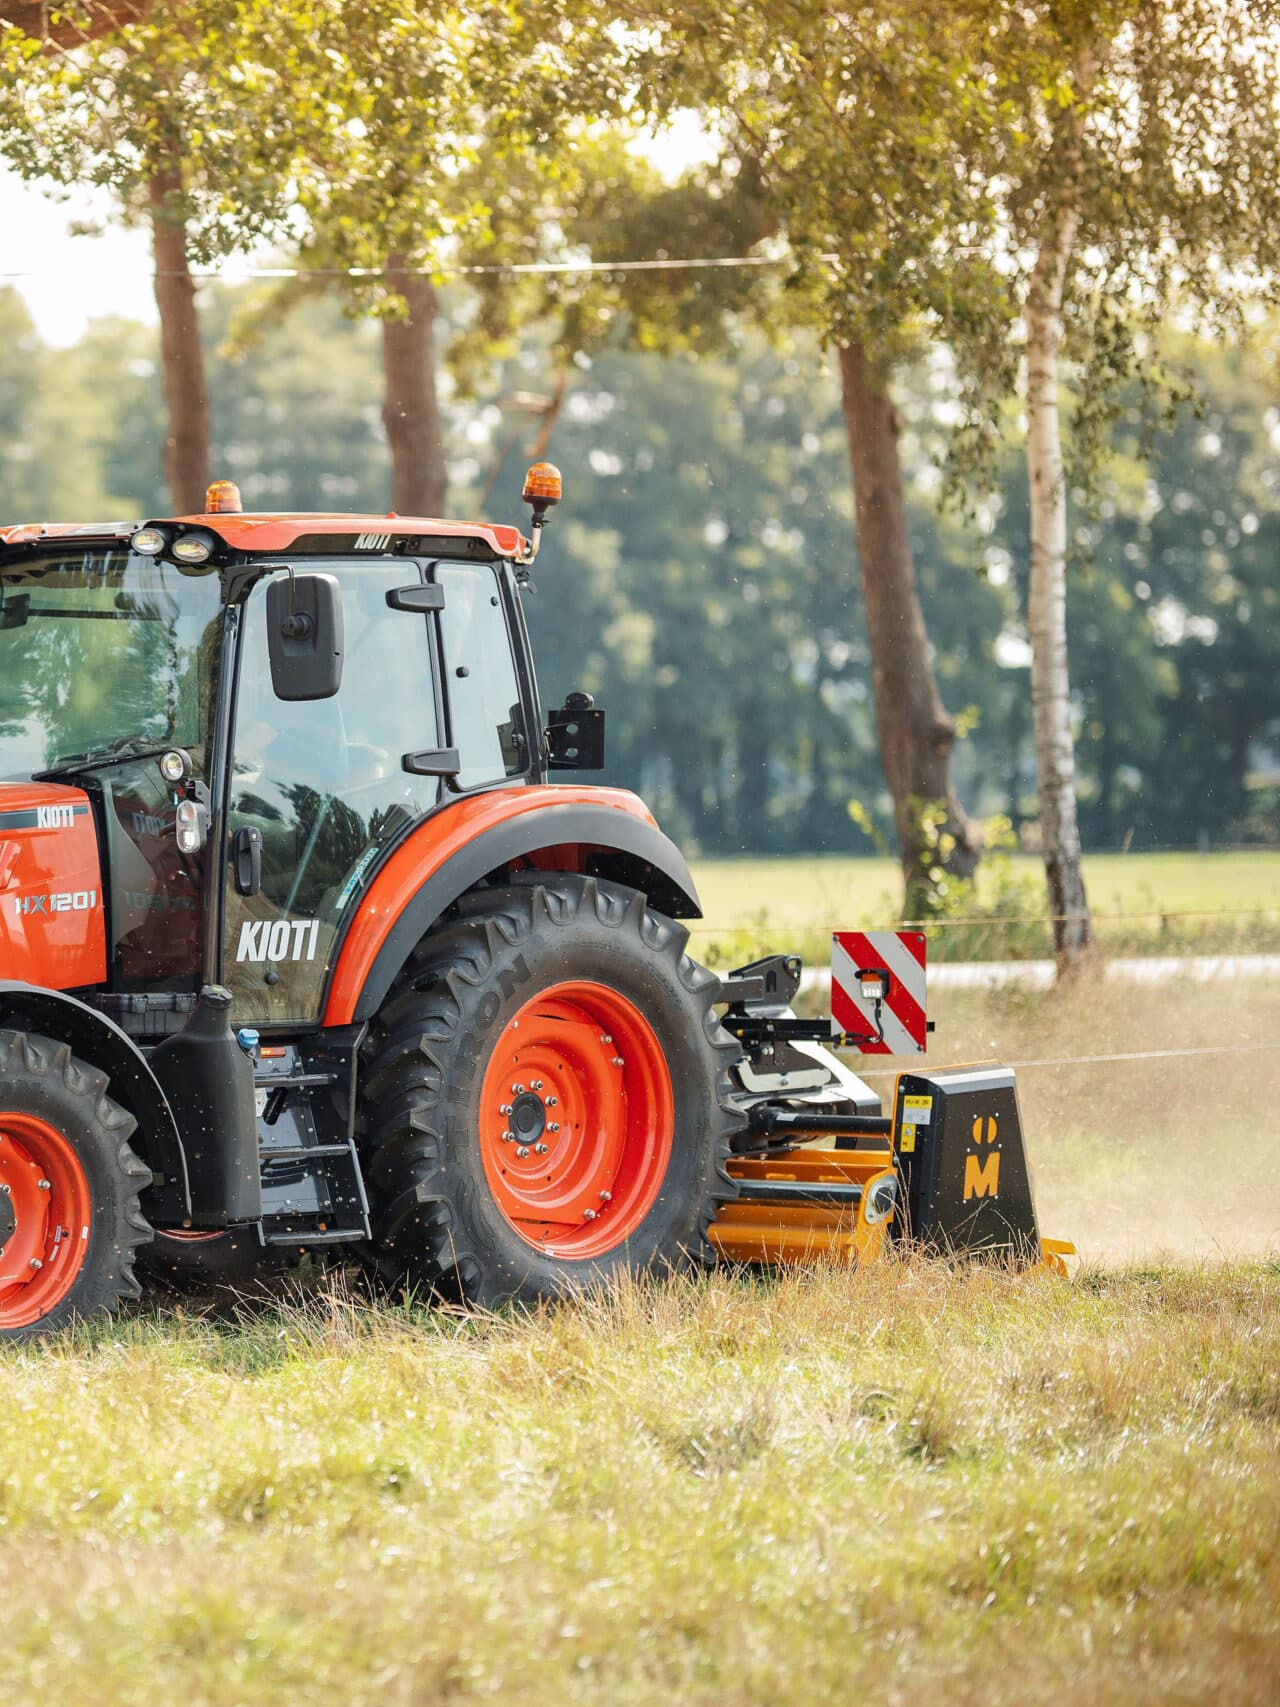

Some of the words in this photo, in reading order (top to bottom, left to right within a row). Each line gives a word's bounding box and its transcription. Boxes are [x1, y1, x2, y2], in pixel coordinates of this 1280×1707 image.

[354, 532, 392, 549] KIOTI
[37, 805, 75, 828] KIOTI
[15, 890, 96, 915] HX1201
[236, 919, 320, 962] KIOTI
